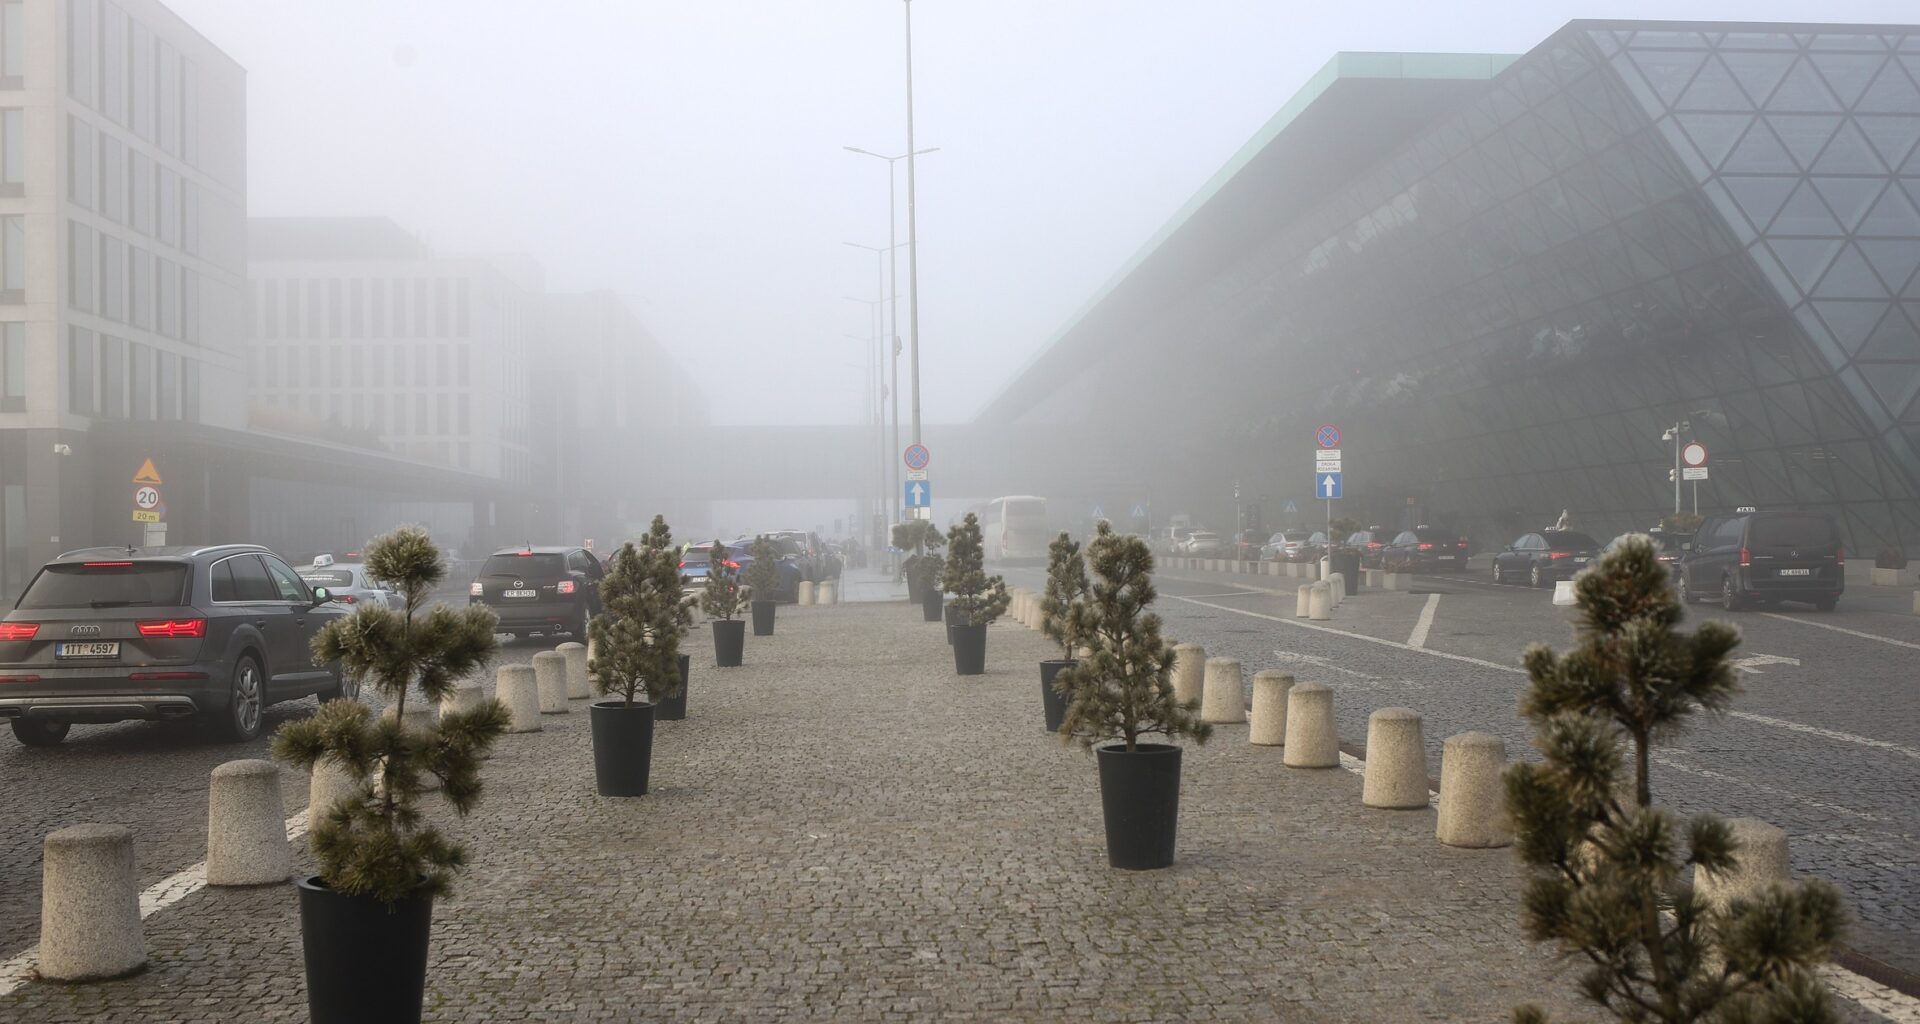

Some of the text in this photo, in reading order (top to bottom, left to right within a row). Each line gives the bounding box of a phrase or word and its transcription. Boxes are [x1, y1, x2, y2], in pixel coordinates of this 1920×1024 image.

[139, 491, 157, 504] 20
[137, 512, 147, 520] 20
[65, 643, 114, 654] 1TT 4597
